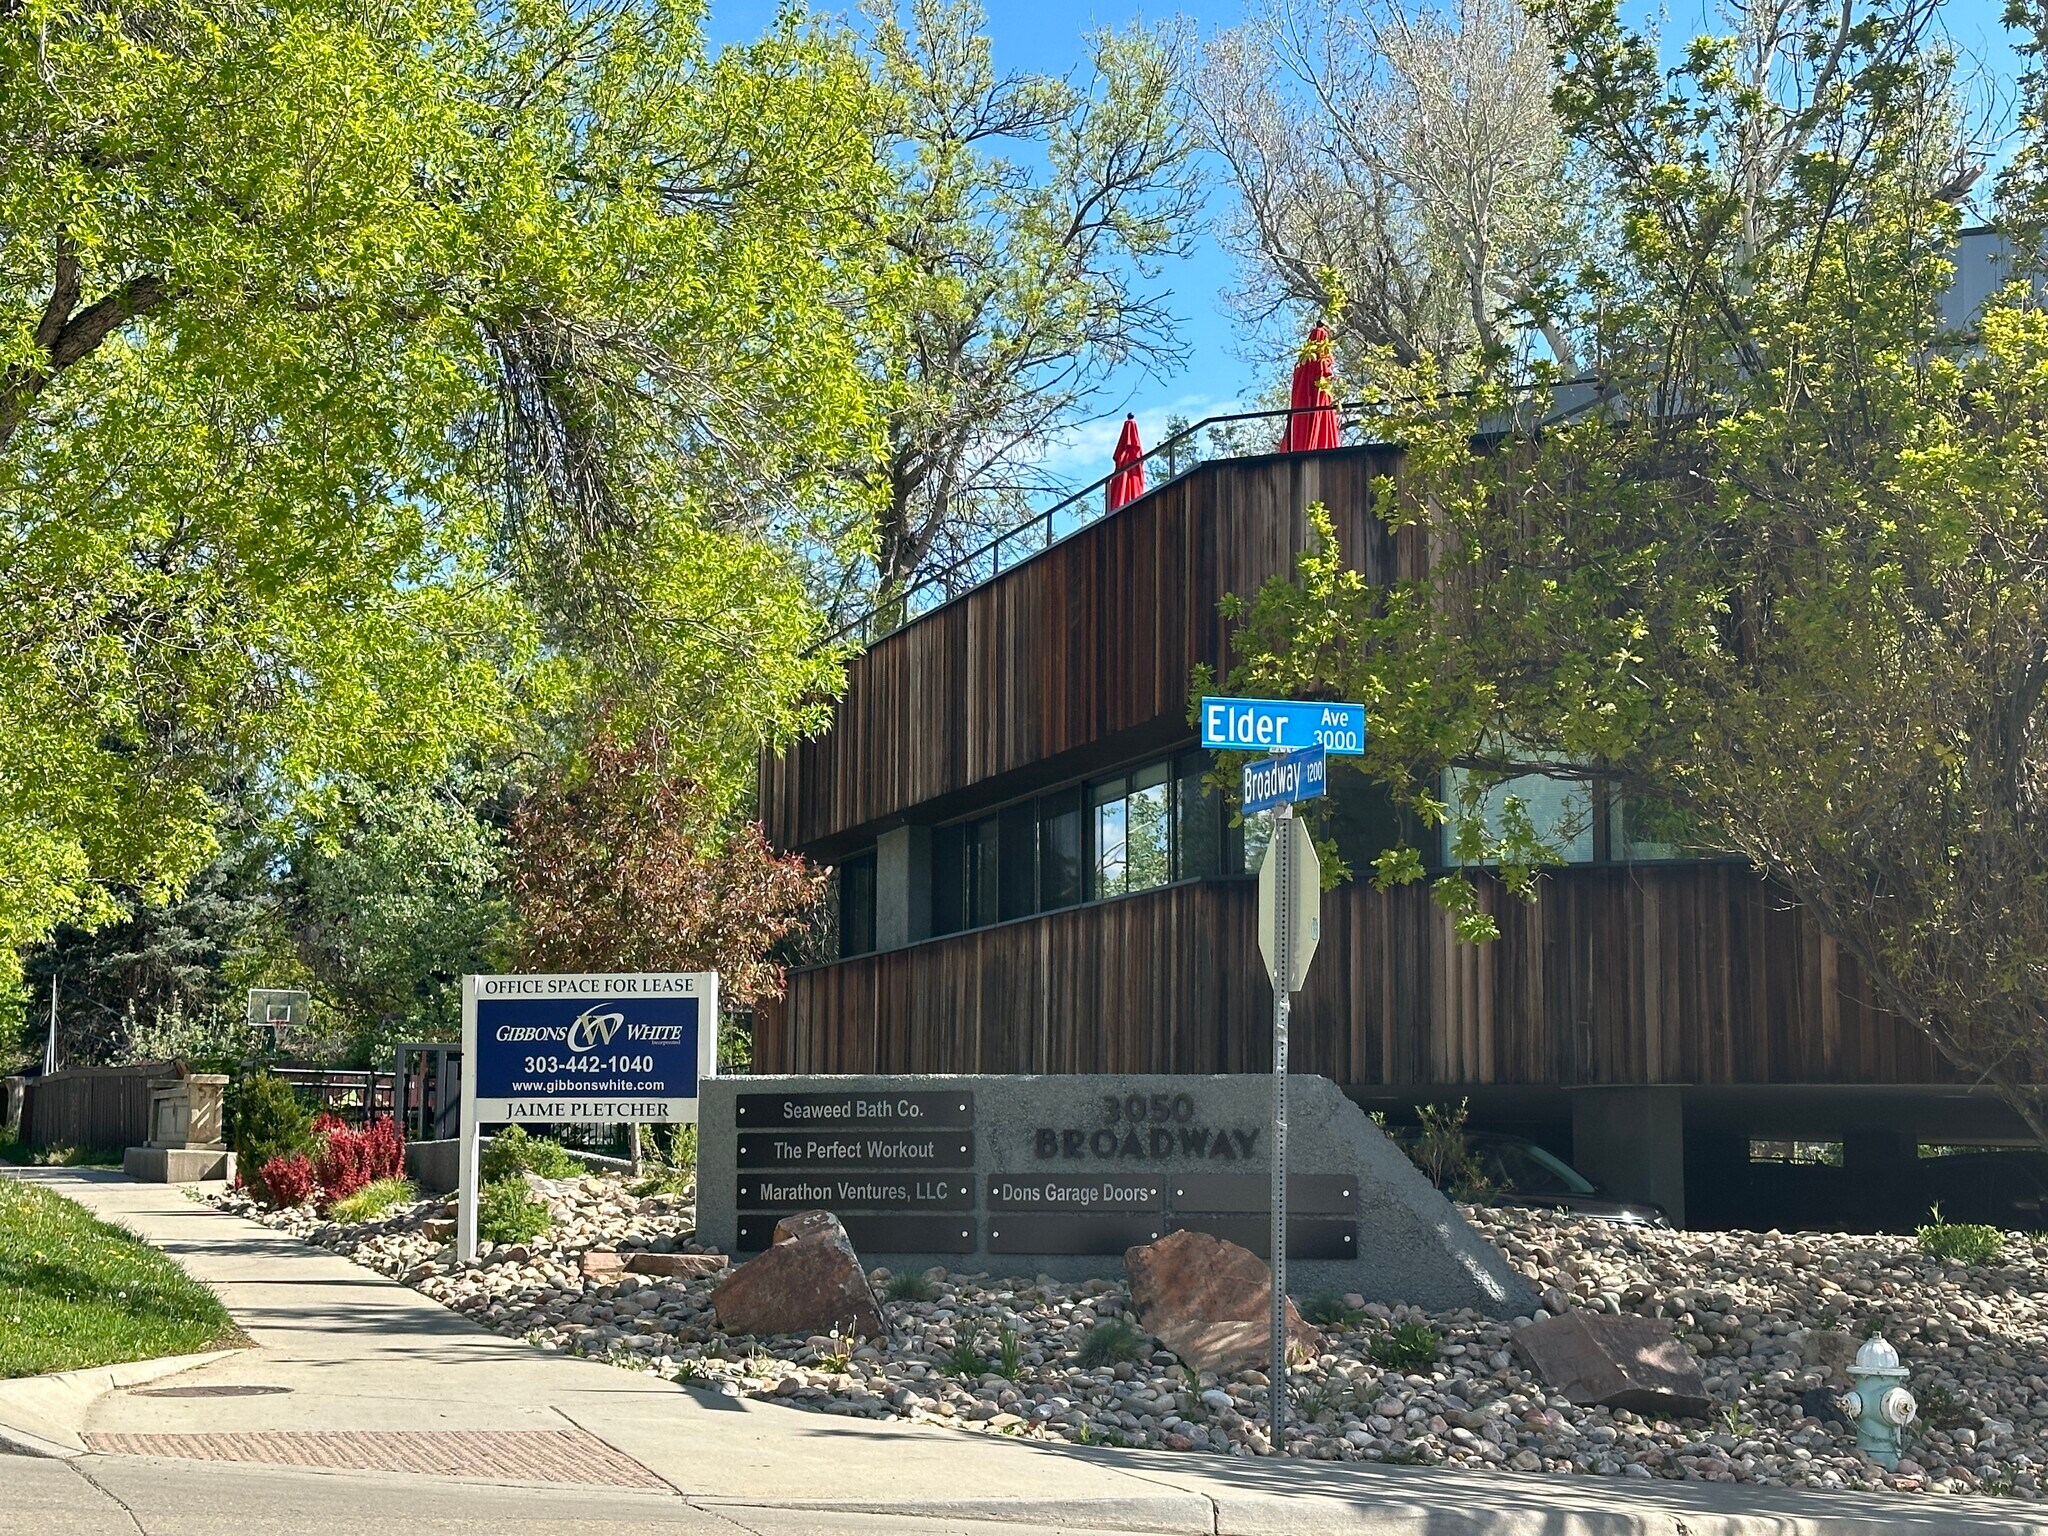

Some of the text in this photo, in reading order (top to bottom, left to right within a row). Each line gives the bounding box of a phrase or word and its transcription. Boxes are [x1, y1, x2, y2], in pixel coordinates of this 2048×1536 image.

[1207, 705, 1289, 744] Elder
[1321, 708, 1349, 727] Ave
[1312, 730, 1357, 750] 3000
[1244, 761, 1323, 804] Broadway 1200
[485, 978, 694, 994] OFFICE SPACE FOR LEASE
[496, 1025, 568, 1041] GIBBONS
[627, 1024, 682, 1040] WHITE
[524, 1055, 654, 1073] 303-442-1040
[512, 1079, 665, 1093] www.gibbonswhite.com
[506, 1102, 669, 1119] JAIME PLETCHER
[783, 1099, 924, 1119] Seaweed Bath Co.
[1103, 1093, 1194, 1124] 3050
[774, 1141, 934, 1159] The Perfect Workout
[1034, 1127, 1261, 1160] BROADWAY
[760, 1182, 948, 1202] Marathon Ventures, LLC
[1002, 1183, 1148, 1205] Dons Garage Doors
